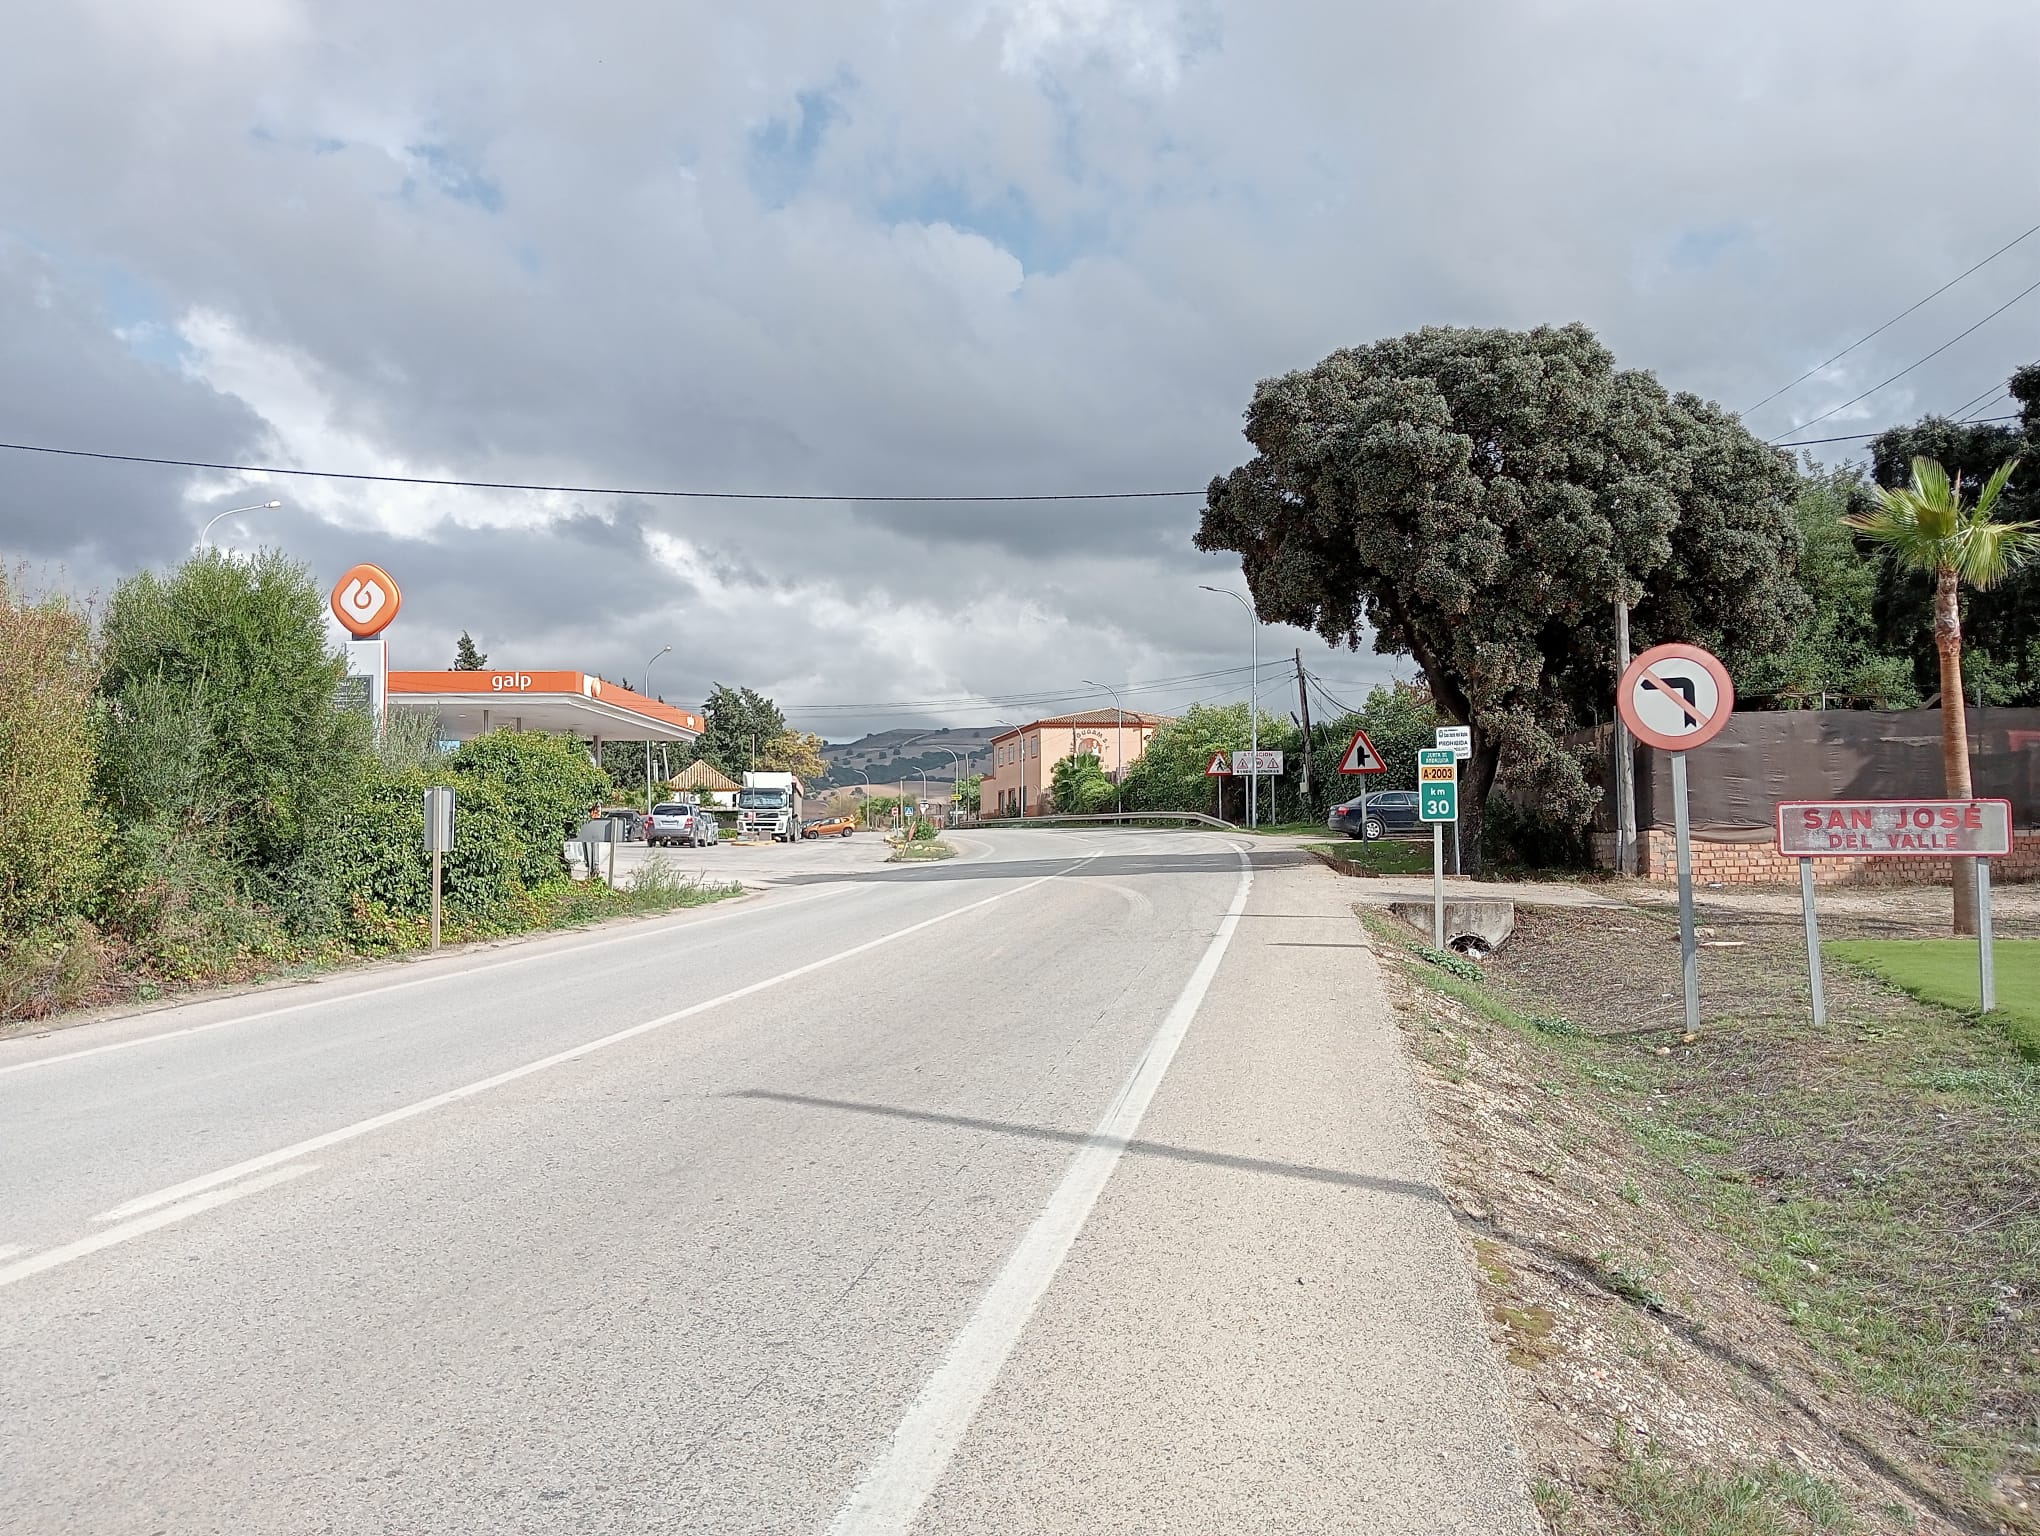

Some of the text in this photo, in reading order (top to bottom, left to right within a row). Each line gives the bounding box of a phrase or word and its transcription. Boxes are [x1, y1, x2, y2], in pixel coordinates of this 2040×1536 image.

[491, 671, 532, 691] galp
[1423, 769, 1453, 779] A-2003
[1430, 788, 1446, 796] km
[1427, 800, 1450, 815] 30
[1803, 803, 1983, 830] SAN JOSÉ
[1828, 833, 1959, 849] DEL VALLE
